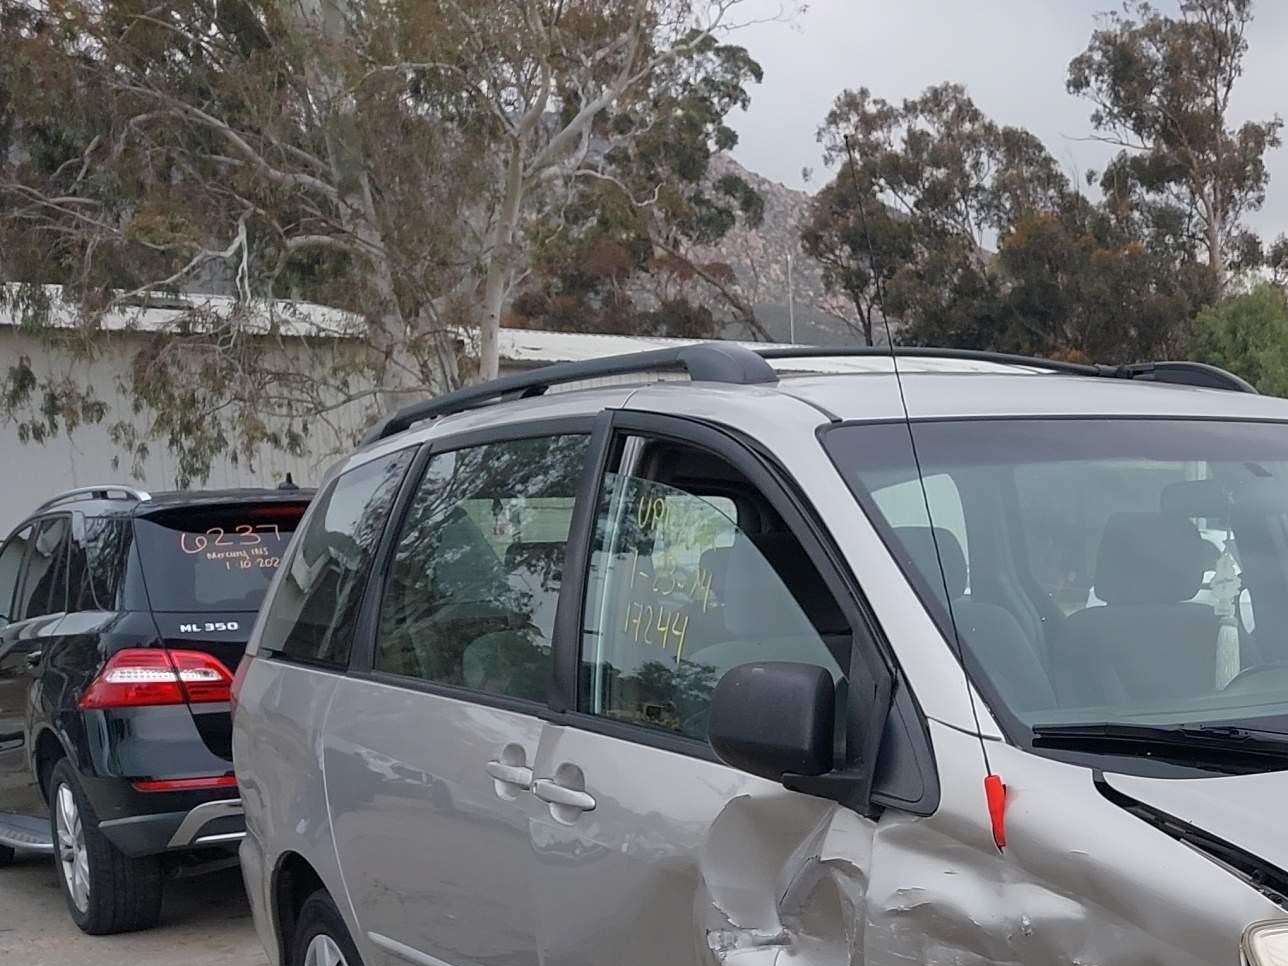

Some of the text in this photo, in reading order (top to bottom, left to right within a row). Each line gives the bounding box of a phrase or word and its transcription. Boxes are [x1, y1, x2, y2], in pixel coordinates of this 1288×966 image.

[181, 524, 281, 554] 6237
[180, 621, 239, 633] ML 350
